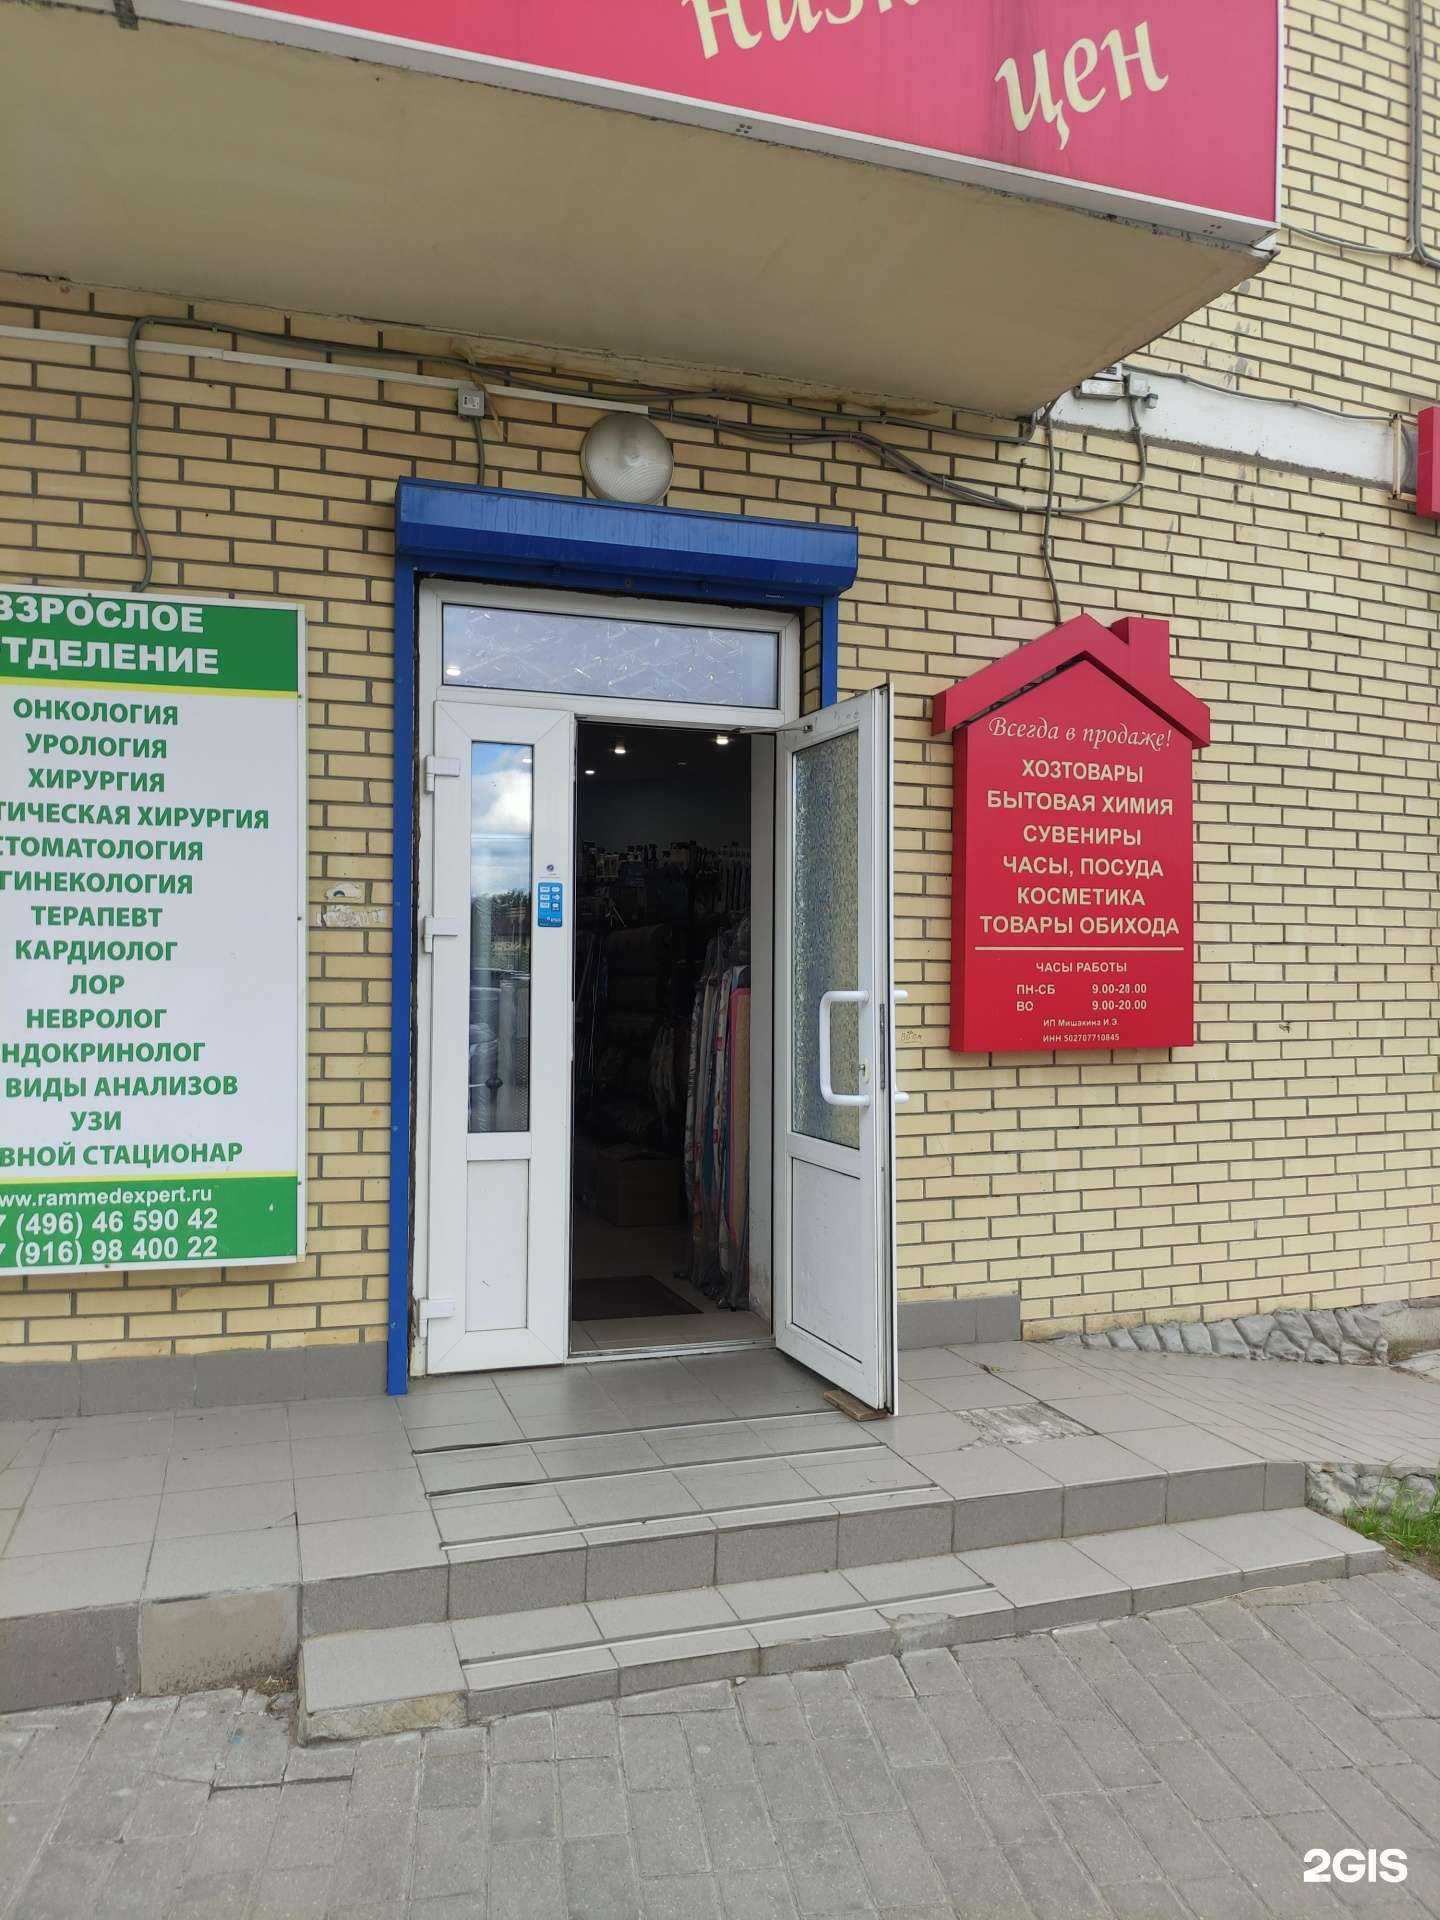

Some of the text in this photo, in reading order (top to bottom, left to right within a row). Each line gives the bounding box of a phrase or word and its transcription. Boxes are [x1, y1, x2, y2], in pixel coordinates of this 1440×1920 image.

[995, 21, 1169, 151] цен
[0, 594, 204, 633] ВЗРОСЛОЕ
[13, 698, 178, 726] ОНКОЛОГИЯ
[25, 733, 167, 759] УРОЛОГИЯ
[988, 716, 1173, 752] Всегда в продаже!
[28, 768, 165, 793] ХИРУРГИЯ
[1021, 759, 1143, 783] ХОЗТОВАРЫ
[987, 790, 1173, 815] БЫТОВАЯ ХИМИЯ
[137, 806, 269, 829] ХИРУРГИЯ
[1023, 824, 1142, 846] СУВЕНИРЫ
[0, 836, 203, 861] ТОМАТОЛОГИЯ
[1003, 856, 1164, 879] ЧАСЫ, ПОСУДА
[0, 870, 193, 894] ГИНЕКОЛОГИЯ
[1017, 887, 1146, 906] КОСМЕТИКА
[30, 905, 163, 927] ТЕРАПЕВТ
[980, 915, 1180, 937] ТОВАРЫ ОБИХОДА
[15, 939, 178, 964] КАРДИОЛОГ
[1036, 962, 1127, 973] ЧАСЫ РАБОТЫ
[70, 974, 125, 995] ЛОР
[1016, 984, 1056, 995] ПН-СБ
[1091, 1000, 1147, 1010] 9.00-20.00
[26, 1009, 167, 1029] НЕВРОЛОГ
[1043, 1019, 1056, 1027] ИП
[1043, 1034, 1062, 1043] ИНН
[6, 1076, 238, 1102] ВИДЫ АНАЛИЗОВ
[70, 1111, 121, 1131] УЗИ
[82, 1143, 243, 1168] СТАЦИОНАР
[16, 1212, 83, 1241] (496)
[92, 1210, 123, 1233] 46
[133, 1208, 179, 1231] 590
[187, 1207, 218, 1228] 42
[16, 1240, 83, 1268] (916)
[91, 1239, 123, 1262] 98
[132, 1237, 178, 1260] 400
[187, 1235, 218, 1258] 22
